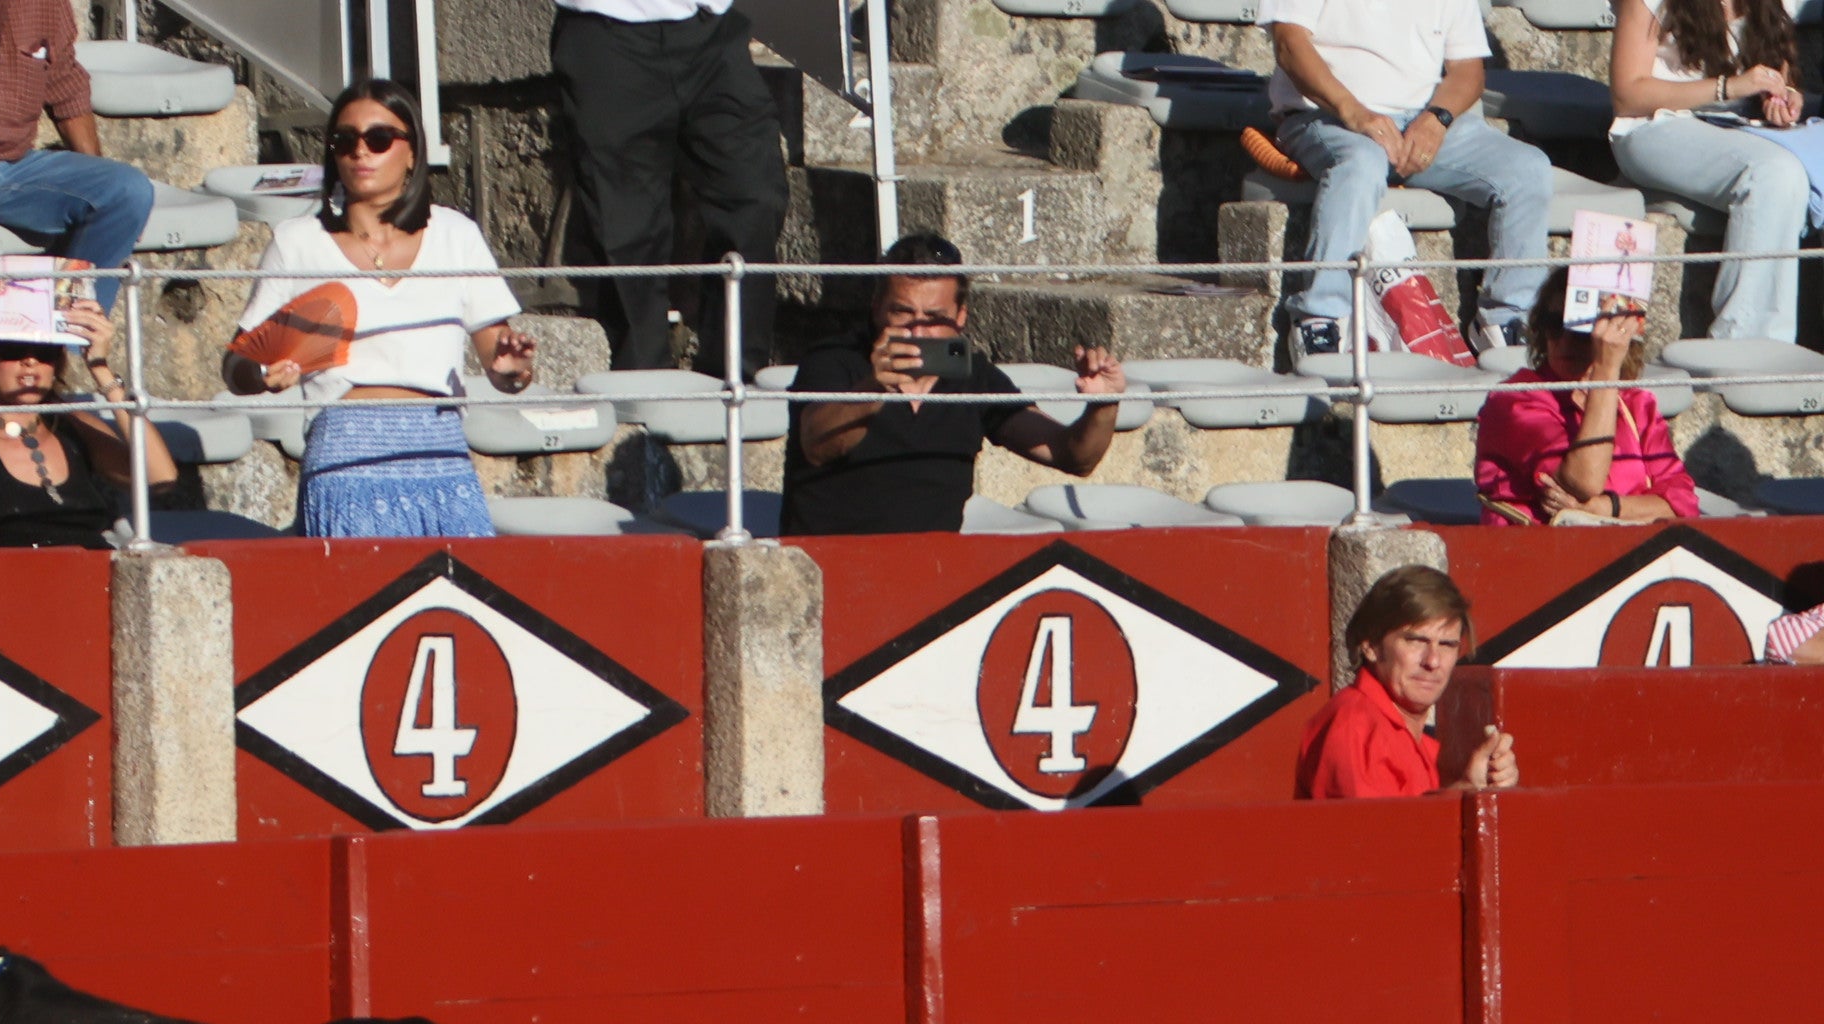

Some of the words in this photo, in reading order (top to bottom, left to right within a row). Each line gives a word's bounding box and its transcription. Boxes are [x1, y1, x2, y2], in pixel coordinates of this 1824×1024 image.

[1017, 188, 1038, 245] 1
[167, 232, 181, 244] 23
[1439, 404, 1455, 415] 22
[1802, 398, 1817, 409] 20
[544, 435, 559, 447] 27
[1012, 616, 1097, 773] 4
[394, 636, 477, 797] 4
